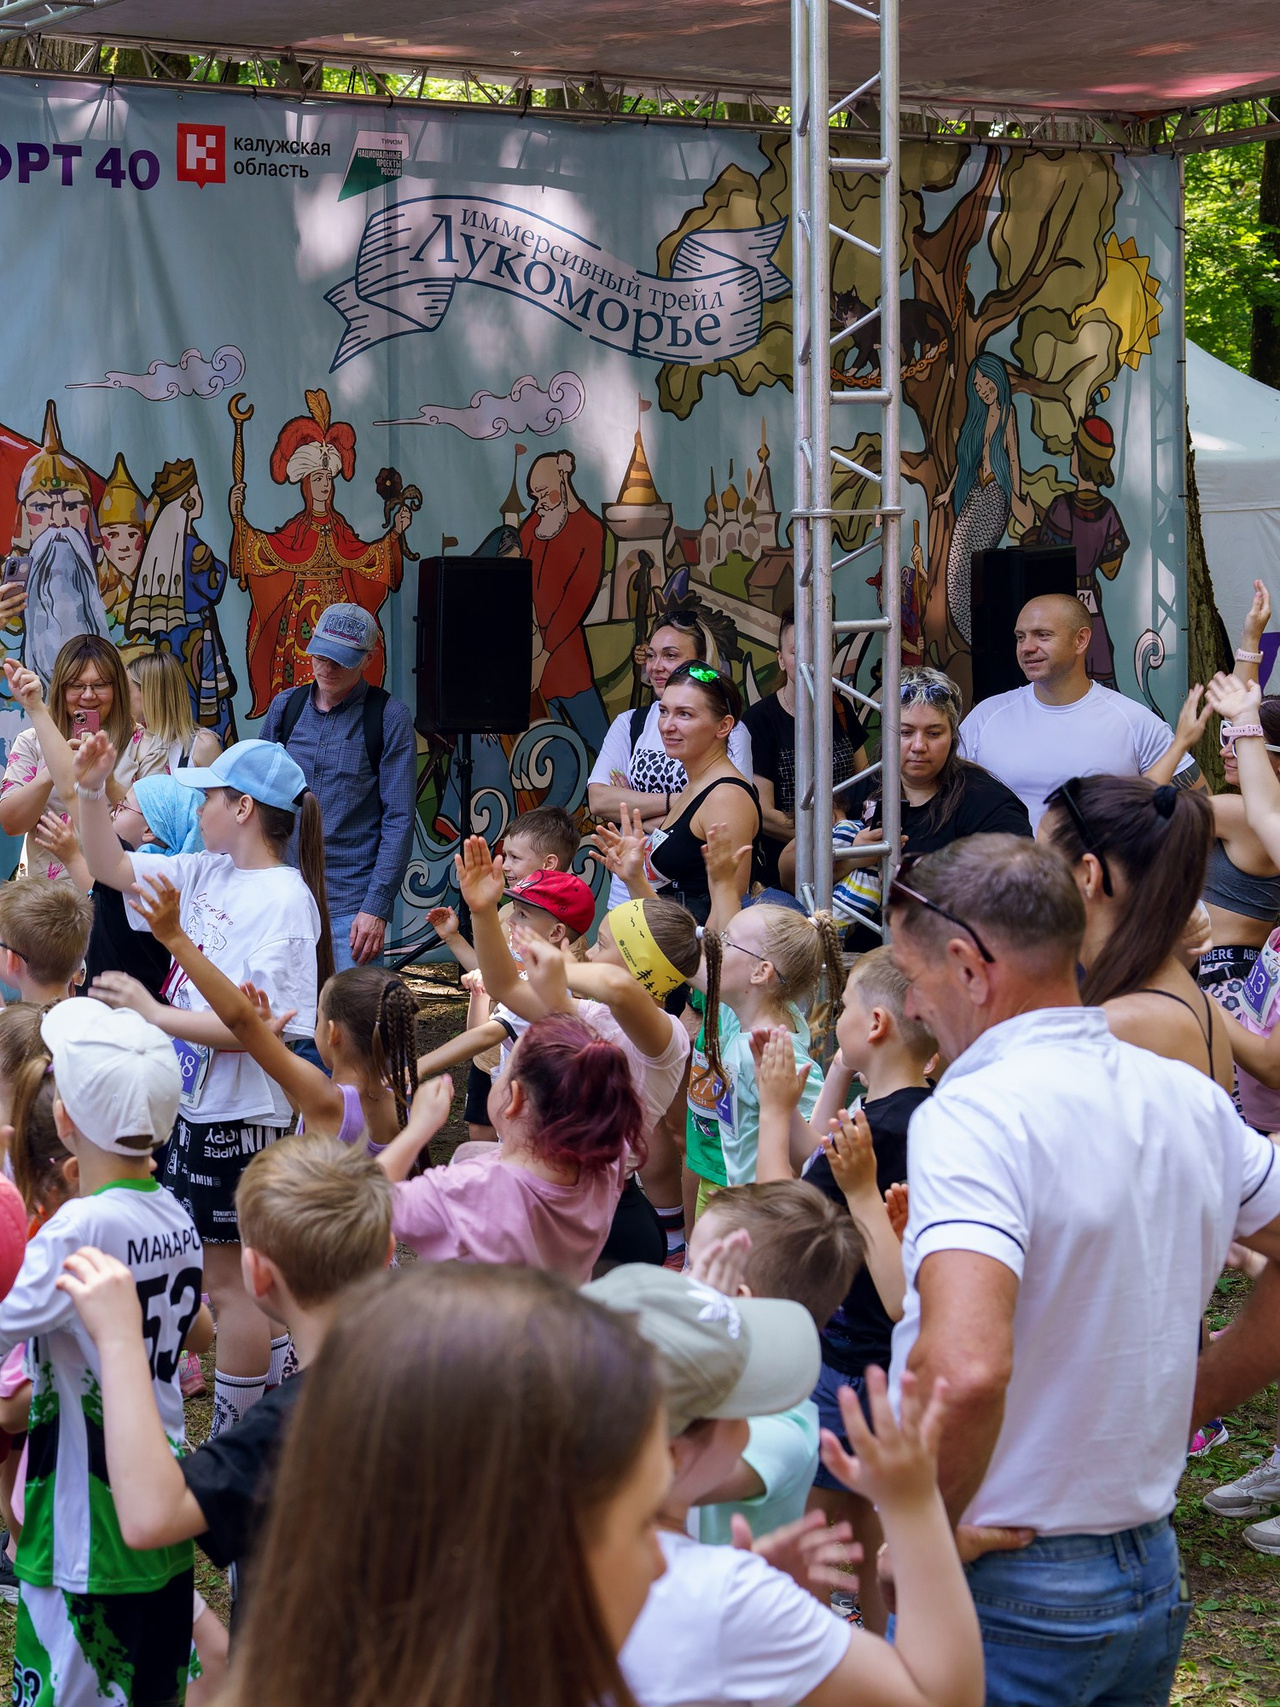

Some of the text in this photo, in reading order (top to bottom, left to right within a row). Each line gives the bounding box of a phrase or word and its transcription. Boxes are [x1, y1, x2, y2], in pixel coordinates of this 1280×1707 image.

[233, 137, 331, 157] калужская
[357, 149, 402, 160] НАЦИОНАЛЬНЫЕ
[95, 148, 160, 191] 40
[233, 157, 309, 179] область
[376, 159, 402, 168] ПРОЕКТЫ
[380, 168, 402, 176] РОССИИ
[460, 208, 725, 318] иммерсивный трейл
[410, 214, 721, 358] Лукоморье
[136, 1267, 203, 1383] 53
